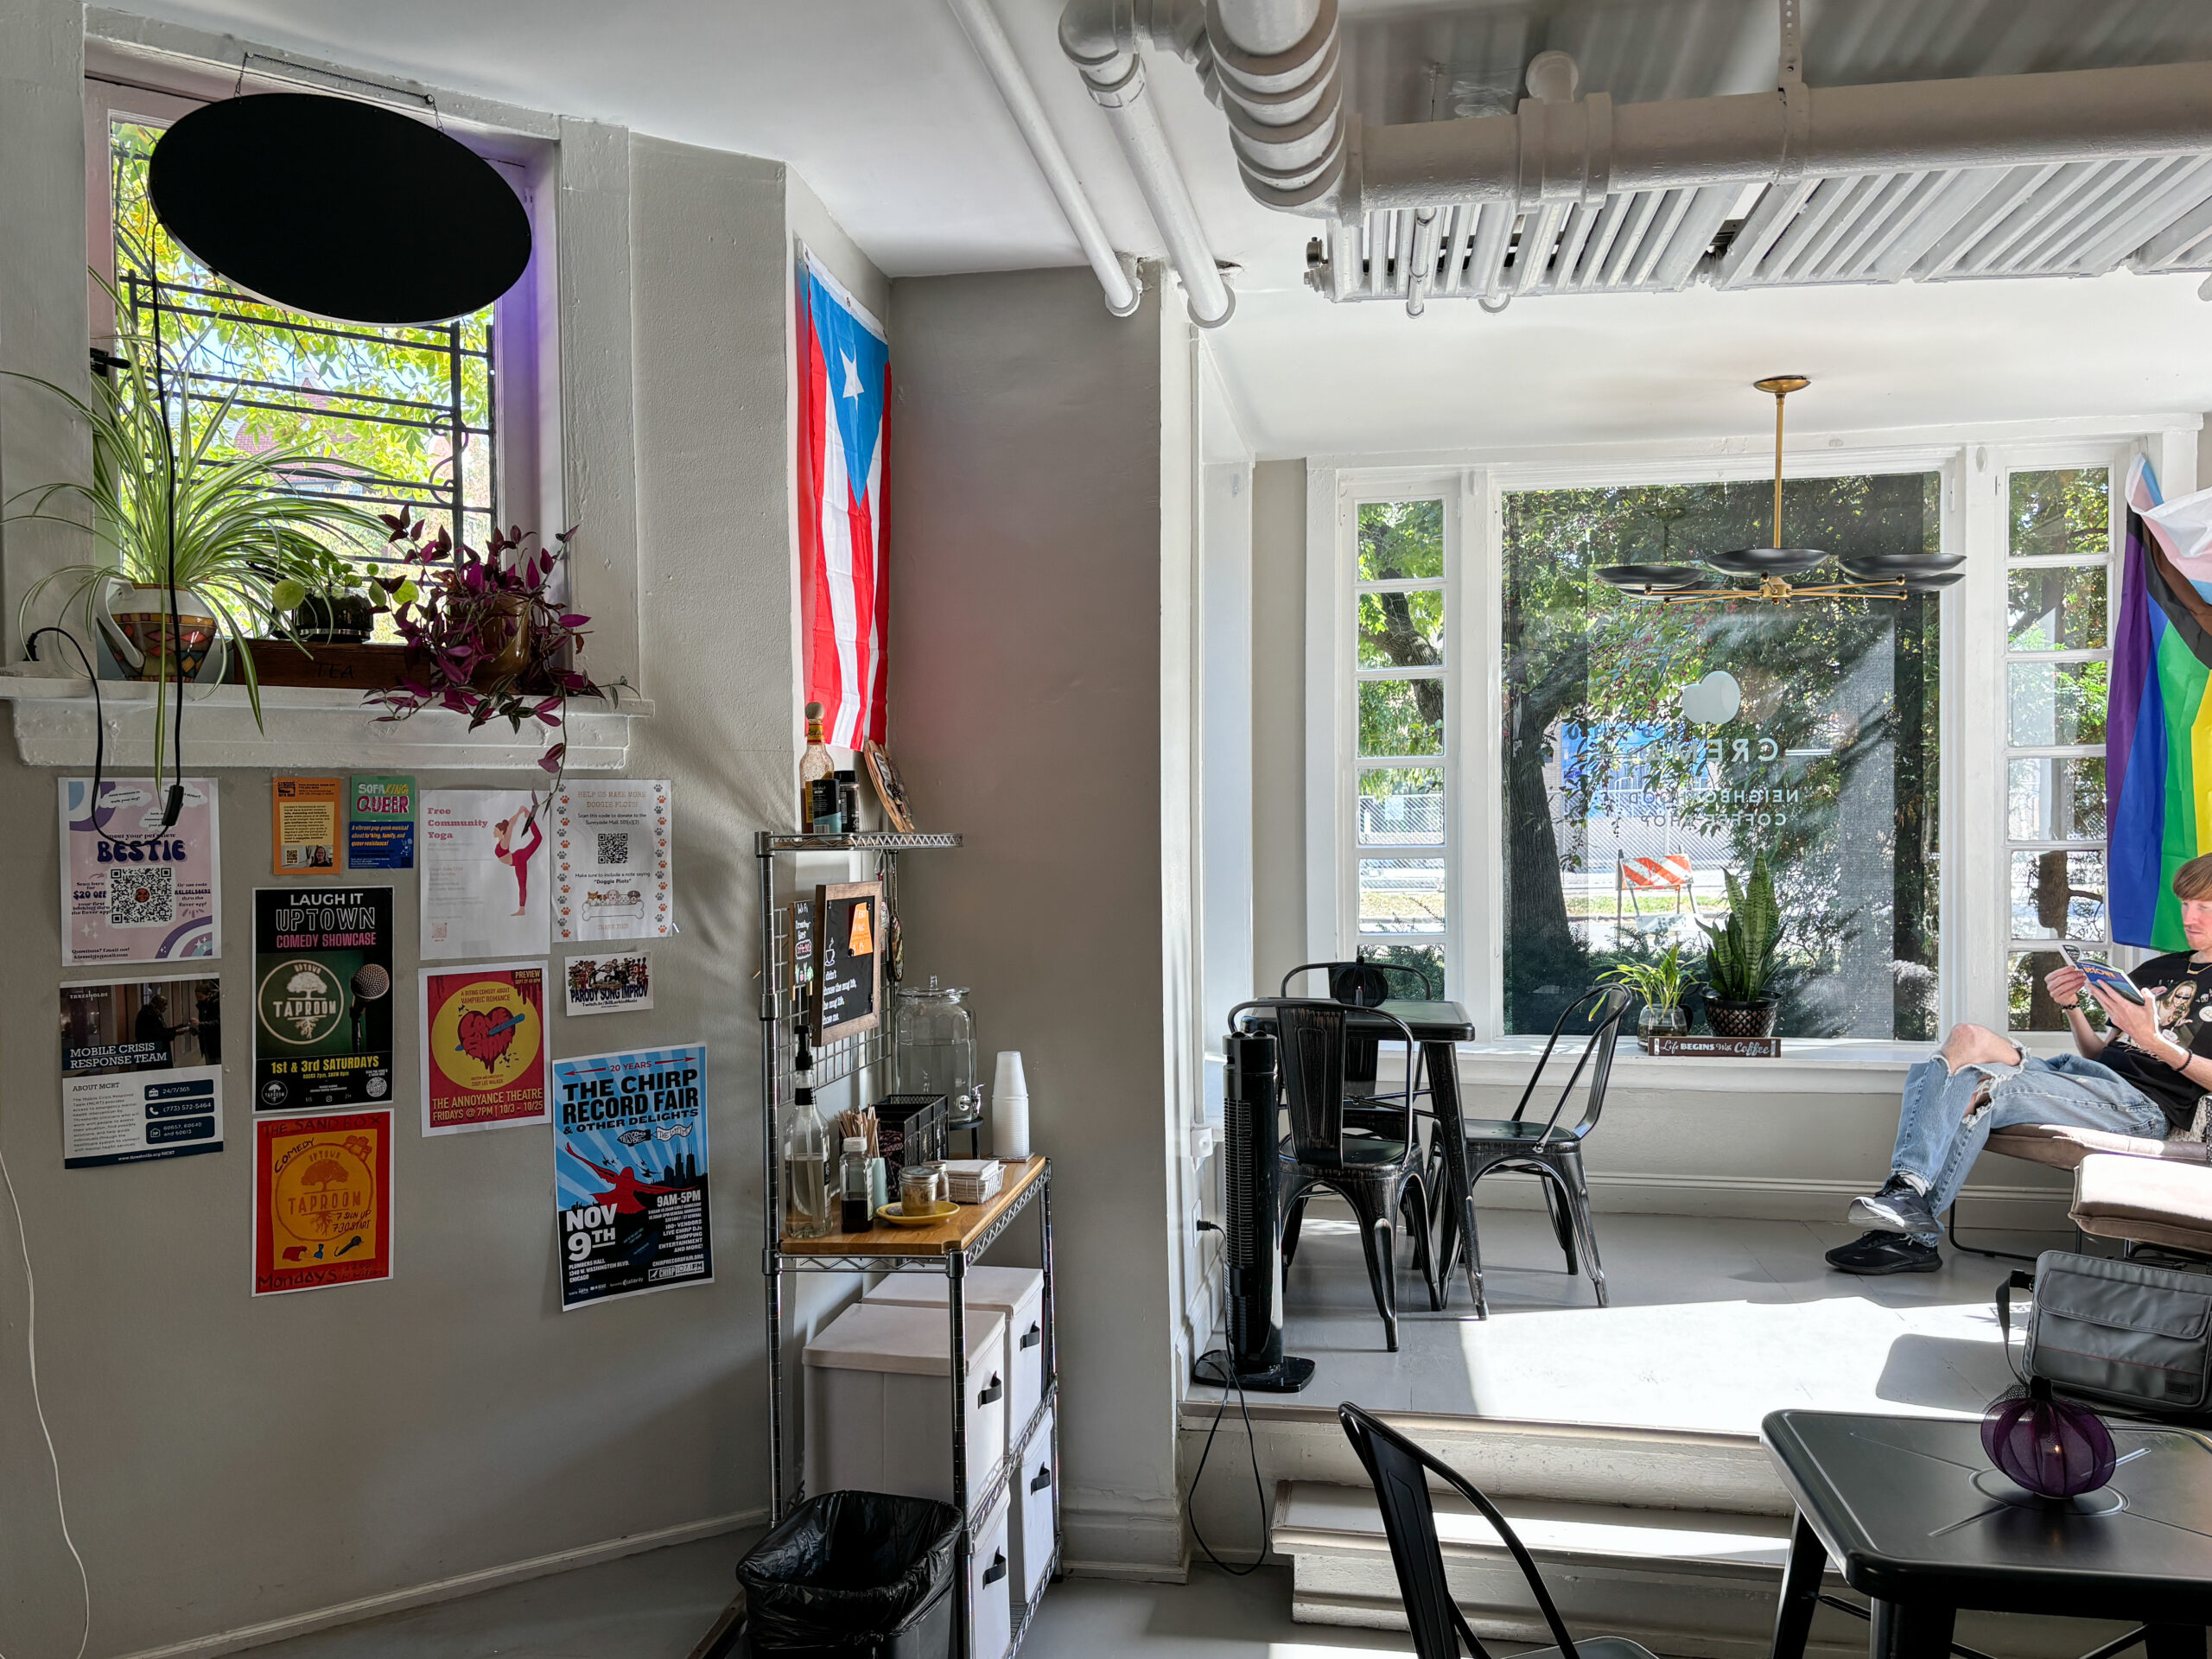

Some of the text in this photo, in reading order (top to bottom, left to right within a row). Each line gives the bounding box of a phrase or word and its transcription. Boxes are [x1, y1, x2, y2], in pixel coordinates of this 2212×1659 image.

[316, 663, 353, 678] TEA
[357, 796, 410, 813] QUEER
[428, 819, 488, 828] Community
[428, 831, 454, 840] Yoga
[97, 839, 186, 862] BESTIE
[73, 890, 91, 900] $20
[290, 893, 364, 906] LAUGH IT
[276, 907, 375, 931] UPTOWN
[276, 932, 377, 949] COMEDY SHOWCASE
[294, 964, 322, 975] UPTOWN
[515, 969, 541, 979] PREVIEW
[825, 969, 836, 982] didn't
[570, 984, 648, 1002] PARODY SONG IMPROV
[842, 981, 850, 991] mug
[273, 1001, 337, 1018] TAPROOM
[829, 999, 837, 1009] mug
[70, 1042, 156, 1058] MOBILE CRISIS
[1660, 1039, 1679, 1054] Life
[1716, 1043, 1732, 1052] With
[1733, 1042, 1770, 1056] Coffee
[70, 1052, 168, 1069] RESPONSE TEAM
[271, 1056, 379, 1074] 1st & 3rd SATURDAYS
[623, 1061, 652, 1070] YEARS
[563, 1068, 698, 1102] THE CHIRP
[432, 1088, 543, 1109] THE ANNOYANCE THEATRE
[563, 1087, 699, 1124] RECORD FAIR
[181, 1102, 211, 1111] 572-5464
[433, 1101, 543, 1122] FRIDAYS @ 7PM 10/3 10/25
[563, 1109, 699, 1135] & OTHER DELIGHTS
[262, 1124, 287, 1139] THE
[274, 1137, 315, 1173] COMEDY
[309, 1150, 340, 1162] UPTOWN
[288, 1192, 361, 1215] TAPROOM
[657, 1190, 702, 1207] 9AM-5PM
[360, 1210, 372, 1219] UP
[566, 1203, 618, 1232] NOV
[658, 1237, 702, 1249] ENTERTAINMENT
[676, 1231, 702, 1241] SHOPPING
[568, 1228, 616, 1262] 9TH
[569, 1261, 593, 1270] PLUMBERS
[586, 1262, 617, 1273] WASHINGTON
[652, 1254, 704, 1267] CHIRPRECORDFAIR.ORG
[569, 1274, 589, 1284] CHICAGO
[658, 1267, 676, 1278] CHIRP
